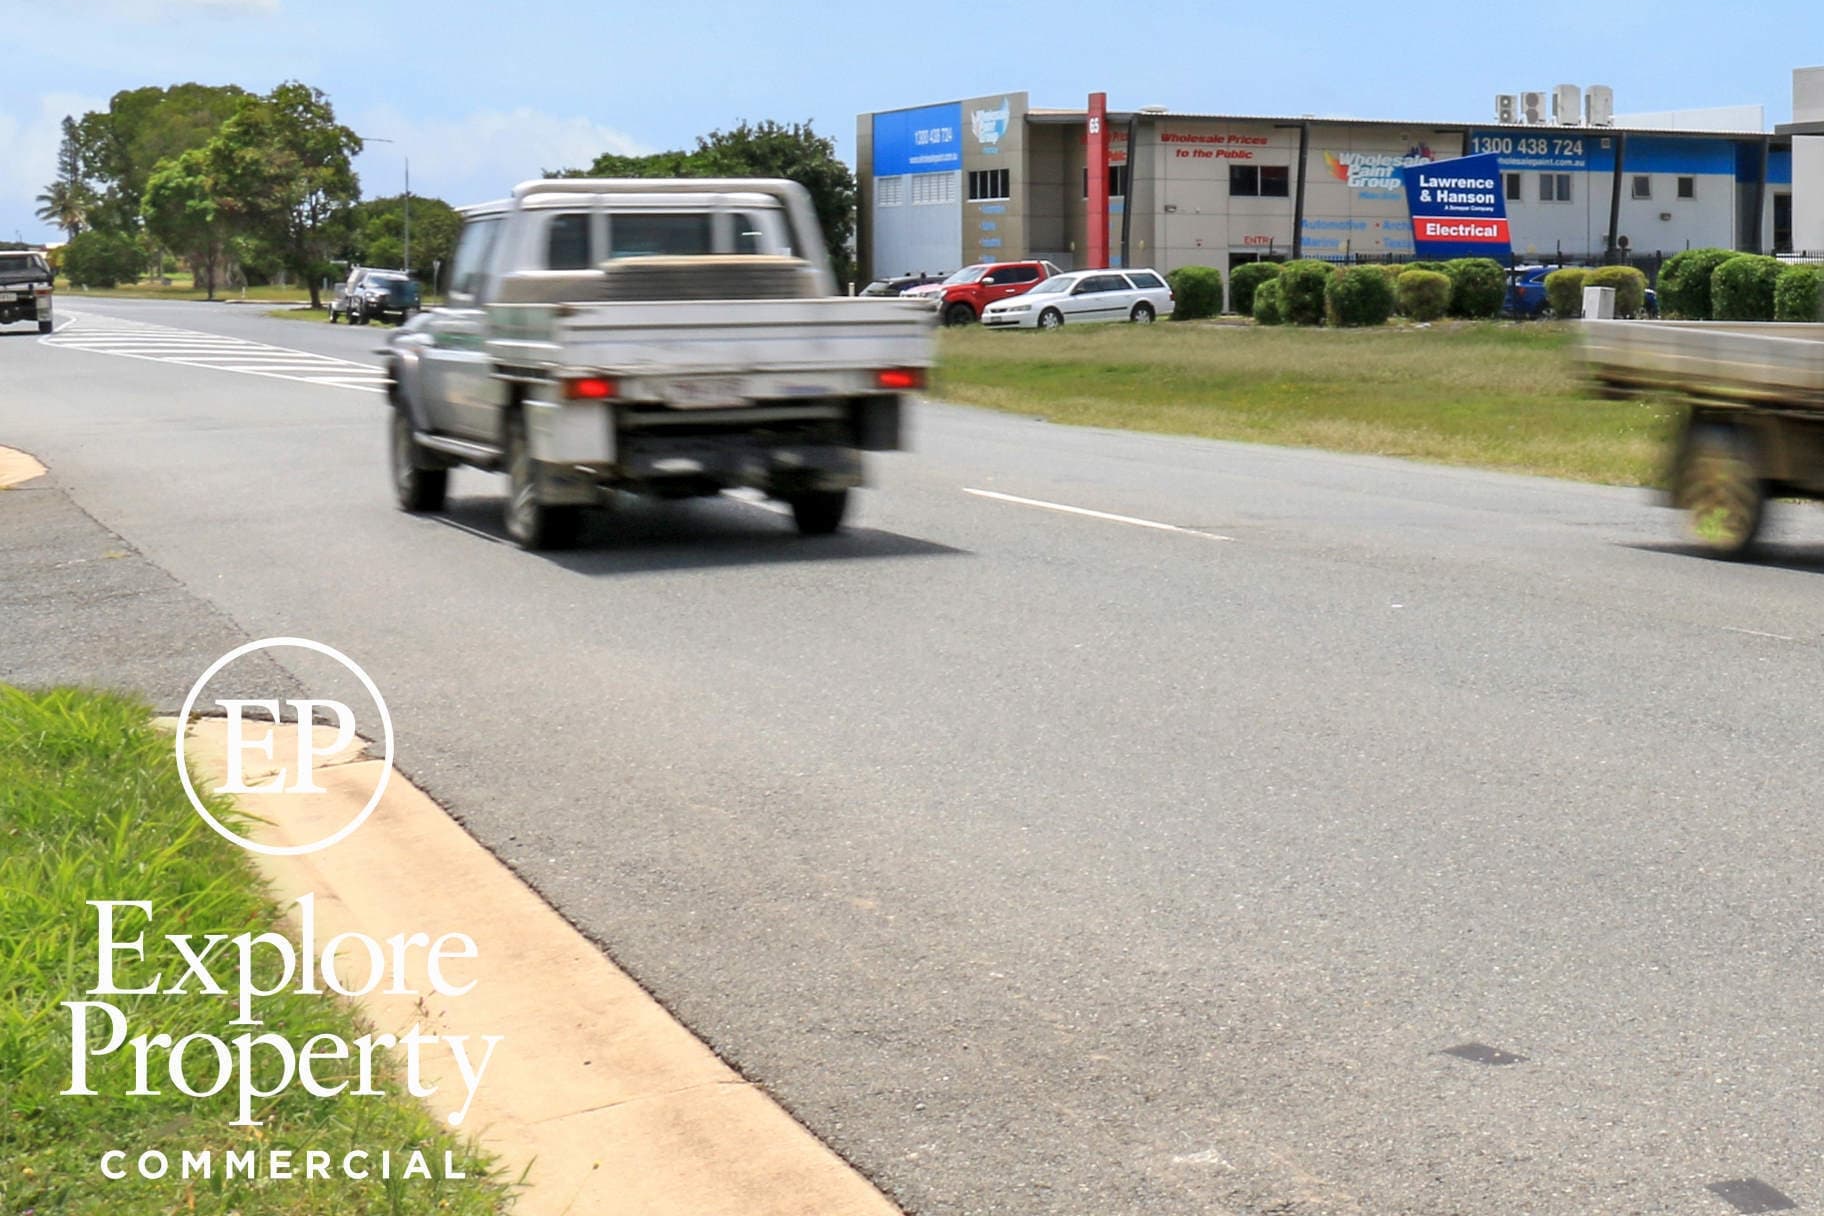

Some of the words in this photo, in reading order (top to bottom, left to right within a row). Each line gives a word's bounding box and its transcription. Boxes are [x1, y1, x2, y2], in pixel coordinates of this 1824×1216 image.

[1089, 117, 1100, 134] 65
[1161, 133, 1225, 144] Wholesale
[1227, 134, 1268, 145] Prices
[1472, 137, 1512, 154] 1300
[1517, 138, 1548, 155] 438
[1552, 139, 1583, 156] 724
[1176, 149, 1189, 158] to
[1193, 149, 1213, 159] the
[1216, 149, 1253, 160] Public
[1340, 152, 1430, 166] Wholesale
[1347, 165, 1395, 178] Paint
[1347, 177, 1402, 191] Group
[1419, 174, 1494, 189] Lawrence
[1419, 189, 1431, 203] &
[1436, 189, 1495, 204] Hanson
[1426, 223, 1498, 238] Electrical
